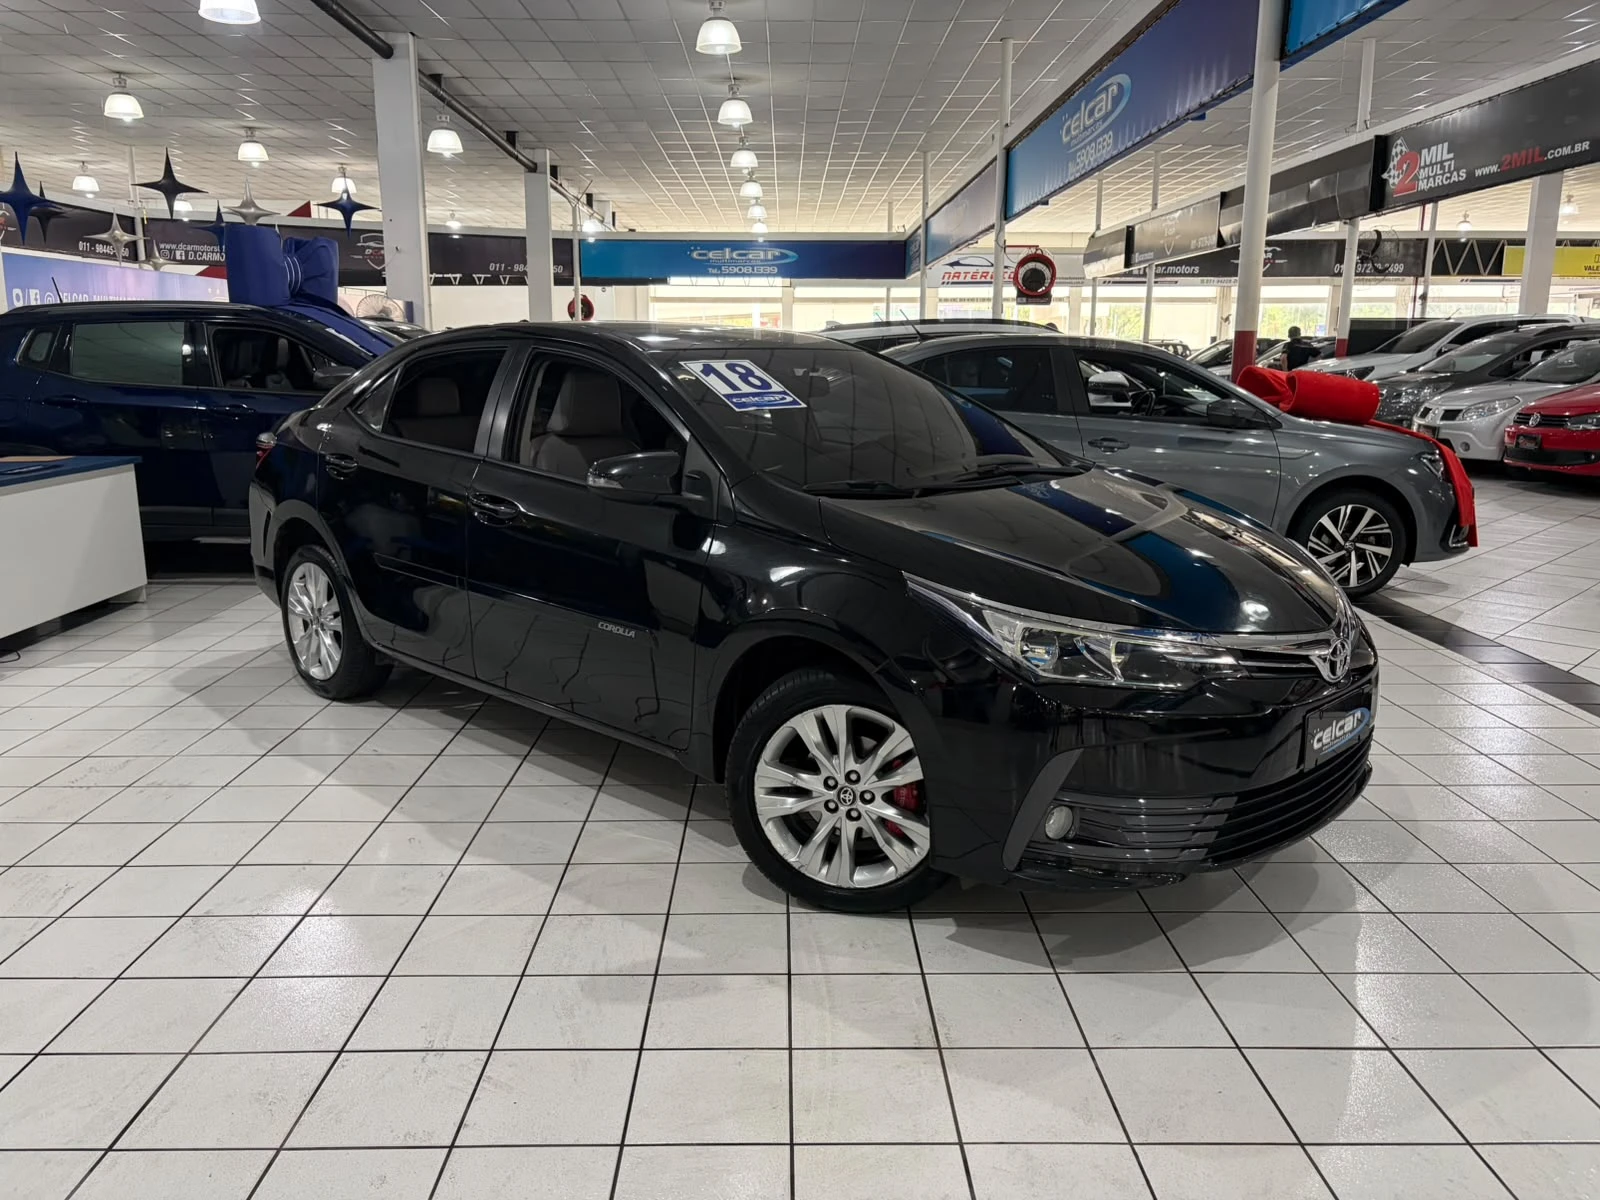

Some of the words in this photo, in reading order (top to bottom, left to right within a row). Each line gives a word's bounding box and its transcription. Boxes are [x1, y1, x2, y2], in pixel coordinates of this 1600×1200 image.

[1062, 83, 1119, 145] celcar
[1394, 152, 1420, 198] 2
[1420, 142, 1455, 167] MIL
[1418, 160, 1455, 180] MULTI
[1418, 169, 1467, 191] MARCAS
[78, 240, 90, 252] 011
[692, 248, 780, 260] celcar
[489, 262, 505, 271] 011
[700, 363, 773, 392] 18
[598, 621, 636, 639] COROLLA
[1313, 710, 1361, 750] celcar
